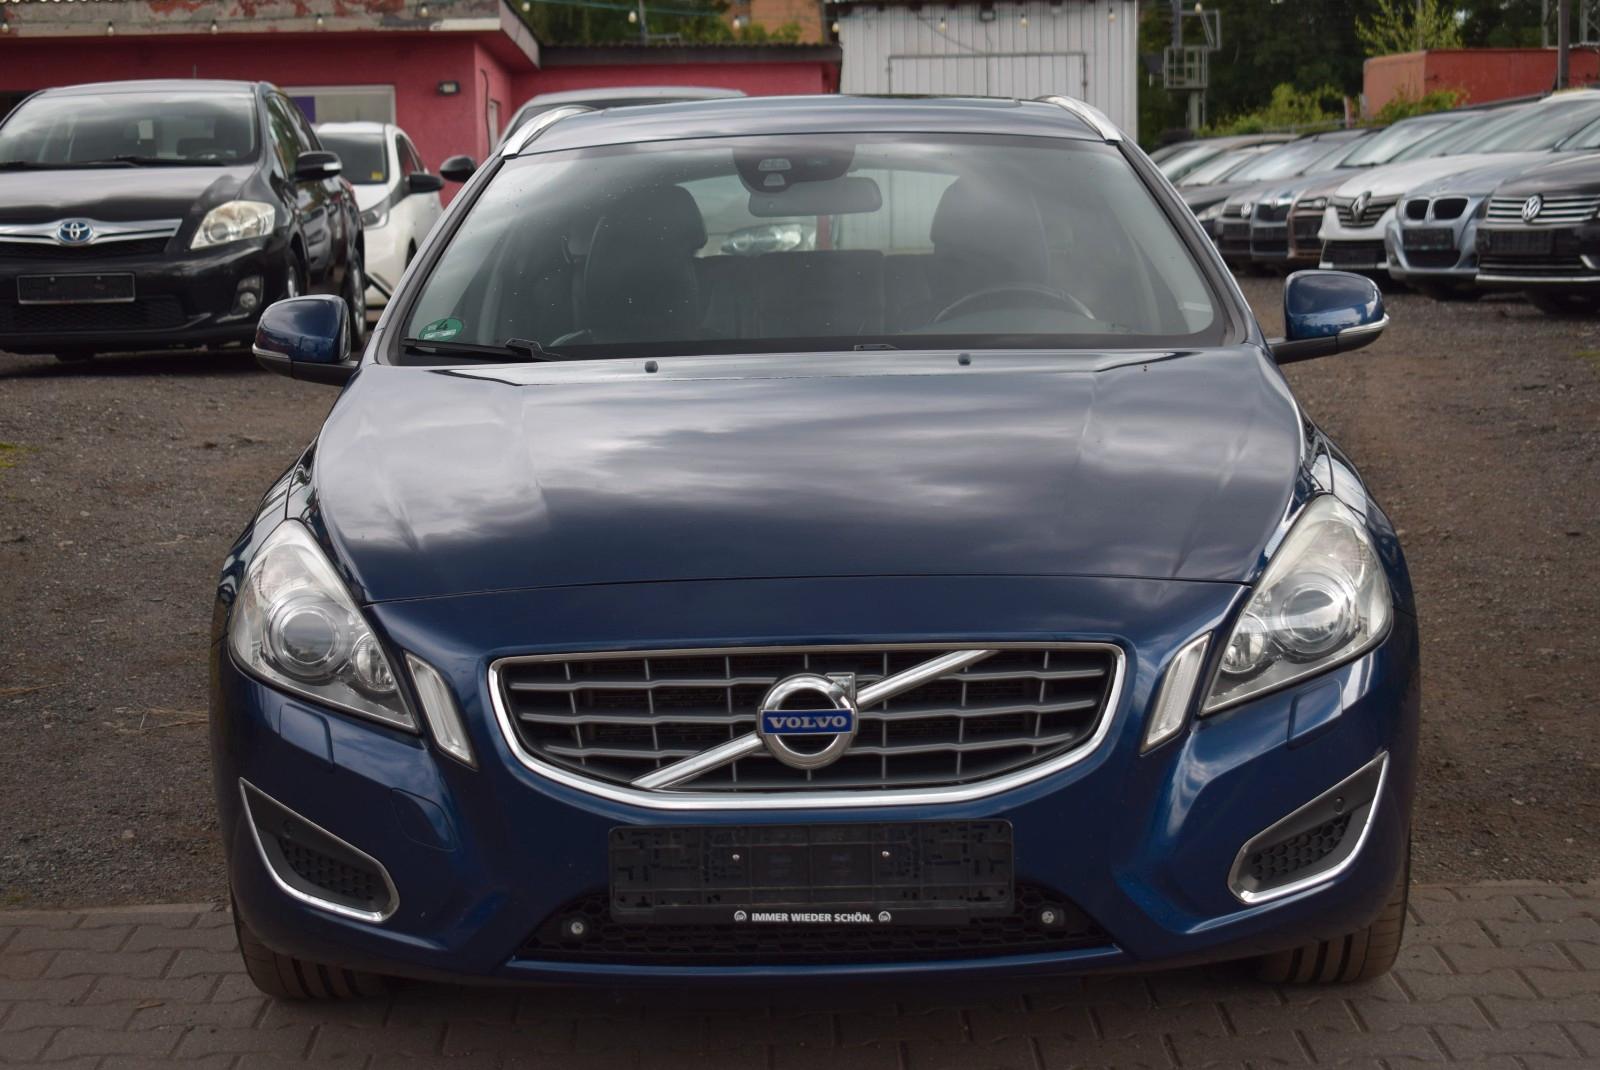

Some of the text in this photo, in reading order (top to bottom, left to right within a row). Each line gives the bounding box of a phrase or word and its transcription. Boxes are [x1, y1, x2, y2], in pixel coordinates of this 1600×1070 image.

[767, 715, 847, 729] VOLVO
[751, 912, 789, 922] IMMER
[790, 912, 832, 922] WIEDER
[834, 911, 873, 922] SCHÖN.
